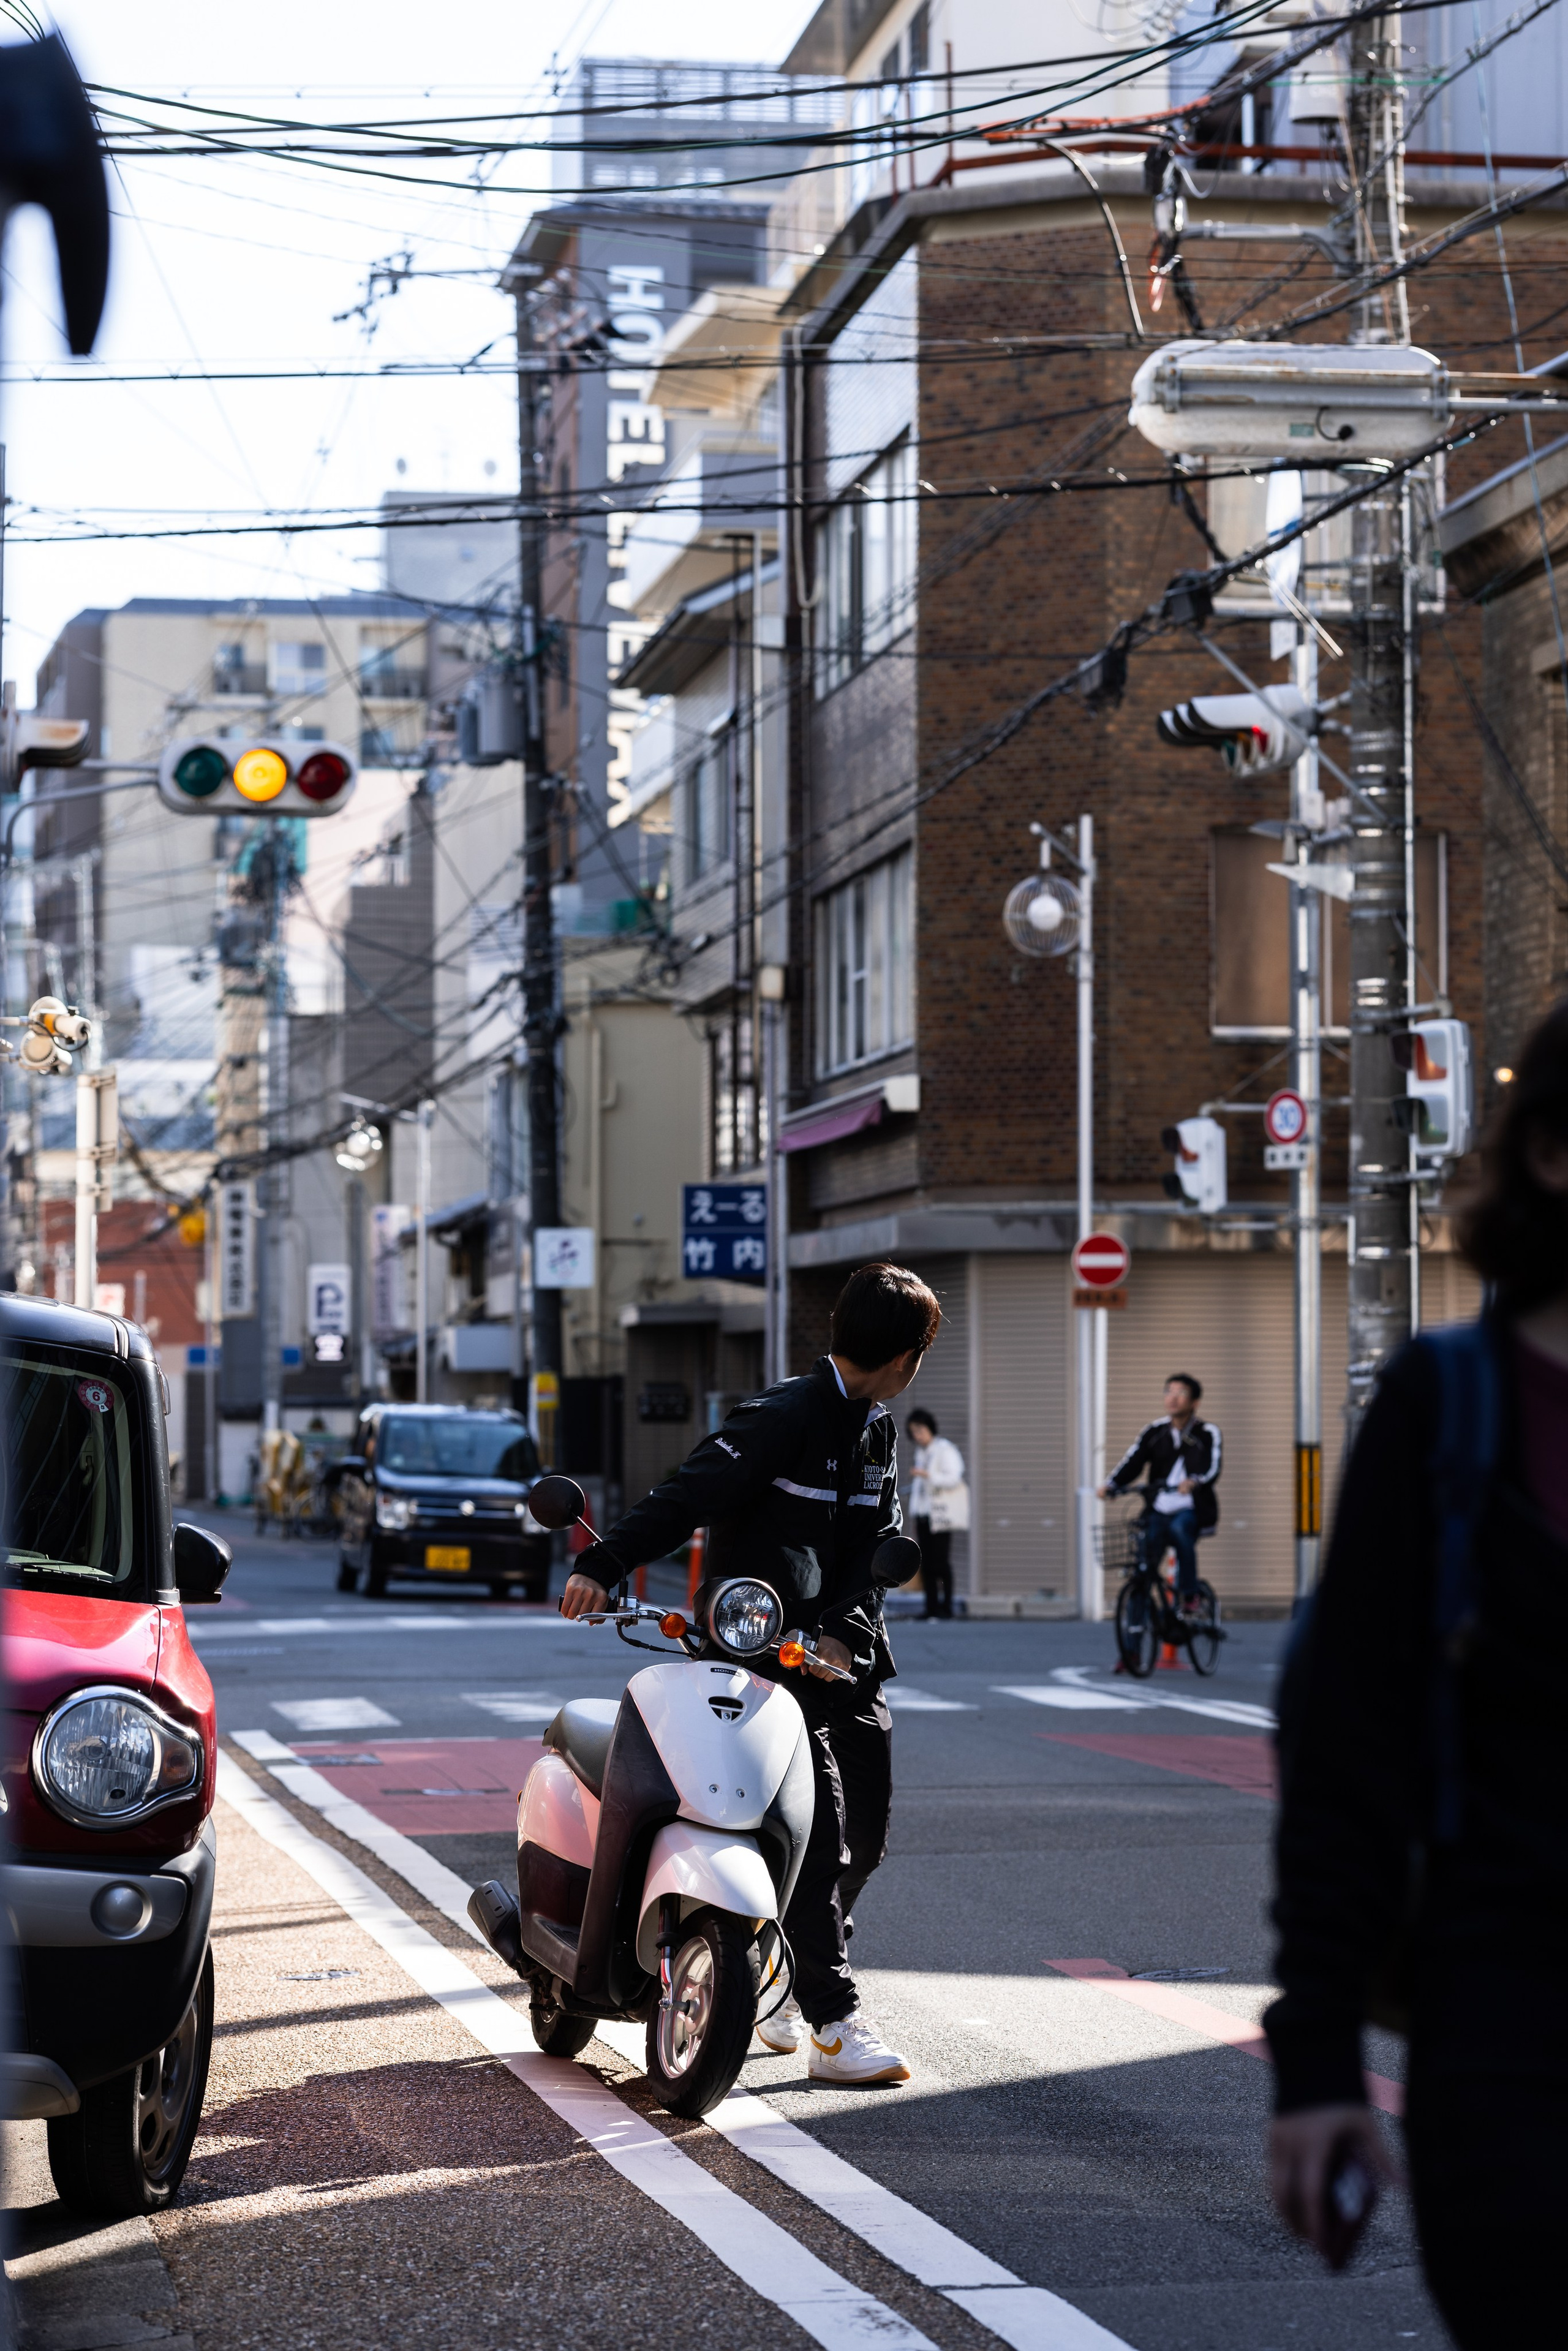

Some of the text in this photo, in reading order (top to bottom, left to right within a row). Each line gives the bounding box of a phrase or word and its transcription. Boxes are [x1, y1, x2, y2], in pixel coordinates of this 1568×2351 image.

[690, 1190, 766, 1223] えーる
[684, 1236, 765, 1270] 竹内
[92, 1391, 100, 1401] 6
[715, 1437, 741, 1459] Daisuke.K
[864, 1465, 880, 1473] KYOTO
